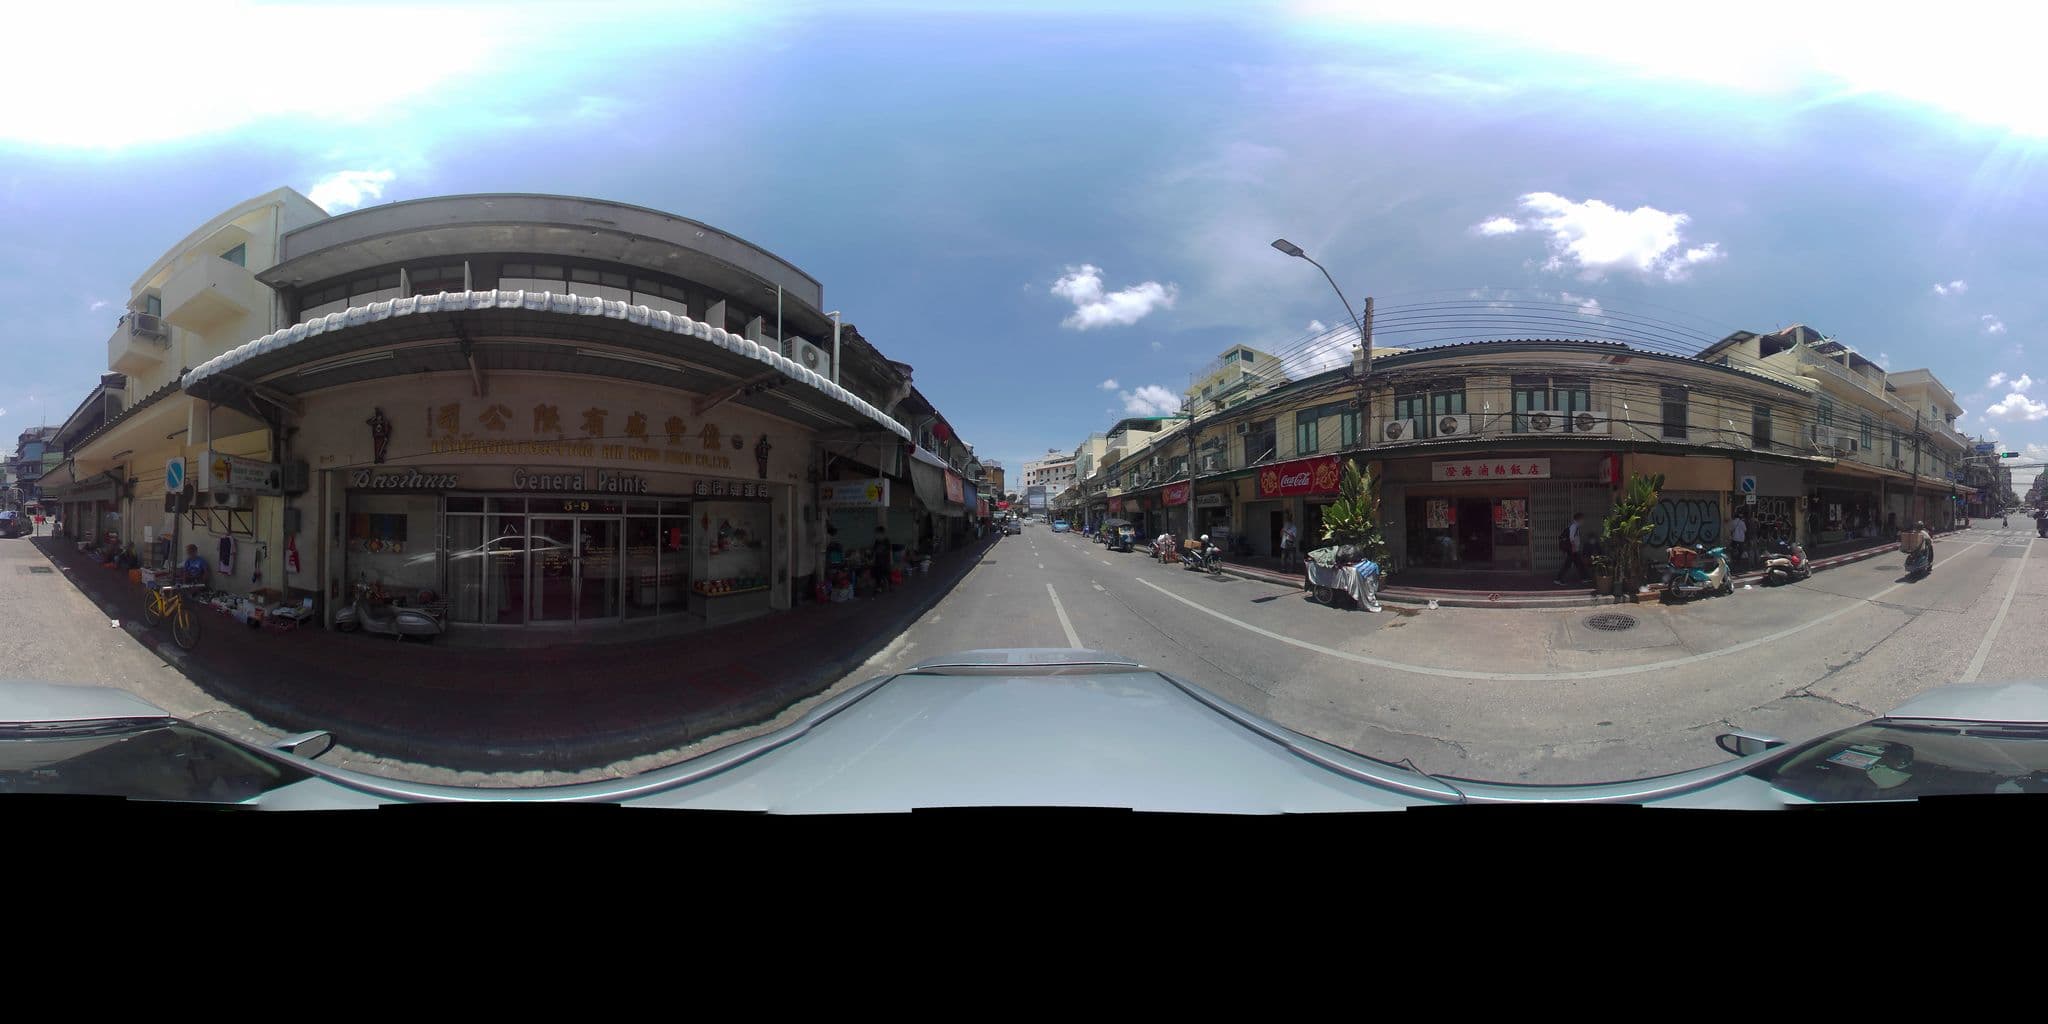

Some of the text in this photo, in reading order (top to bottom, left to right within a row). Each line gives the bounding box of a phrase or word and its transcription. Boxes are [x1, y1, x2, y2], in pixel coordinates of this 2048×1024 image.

[512, 468, 649, 493] General Paints
[1280, 472, 1312, 488] Coca-Cola
